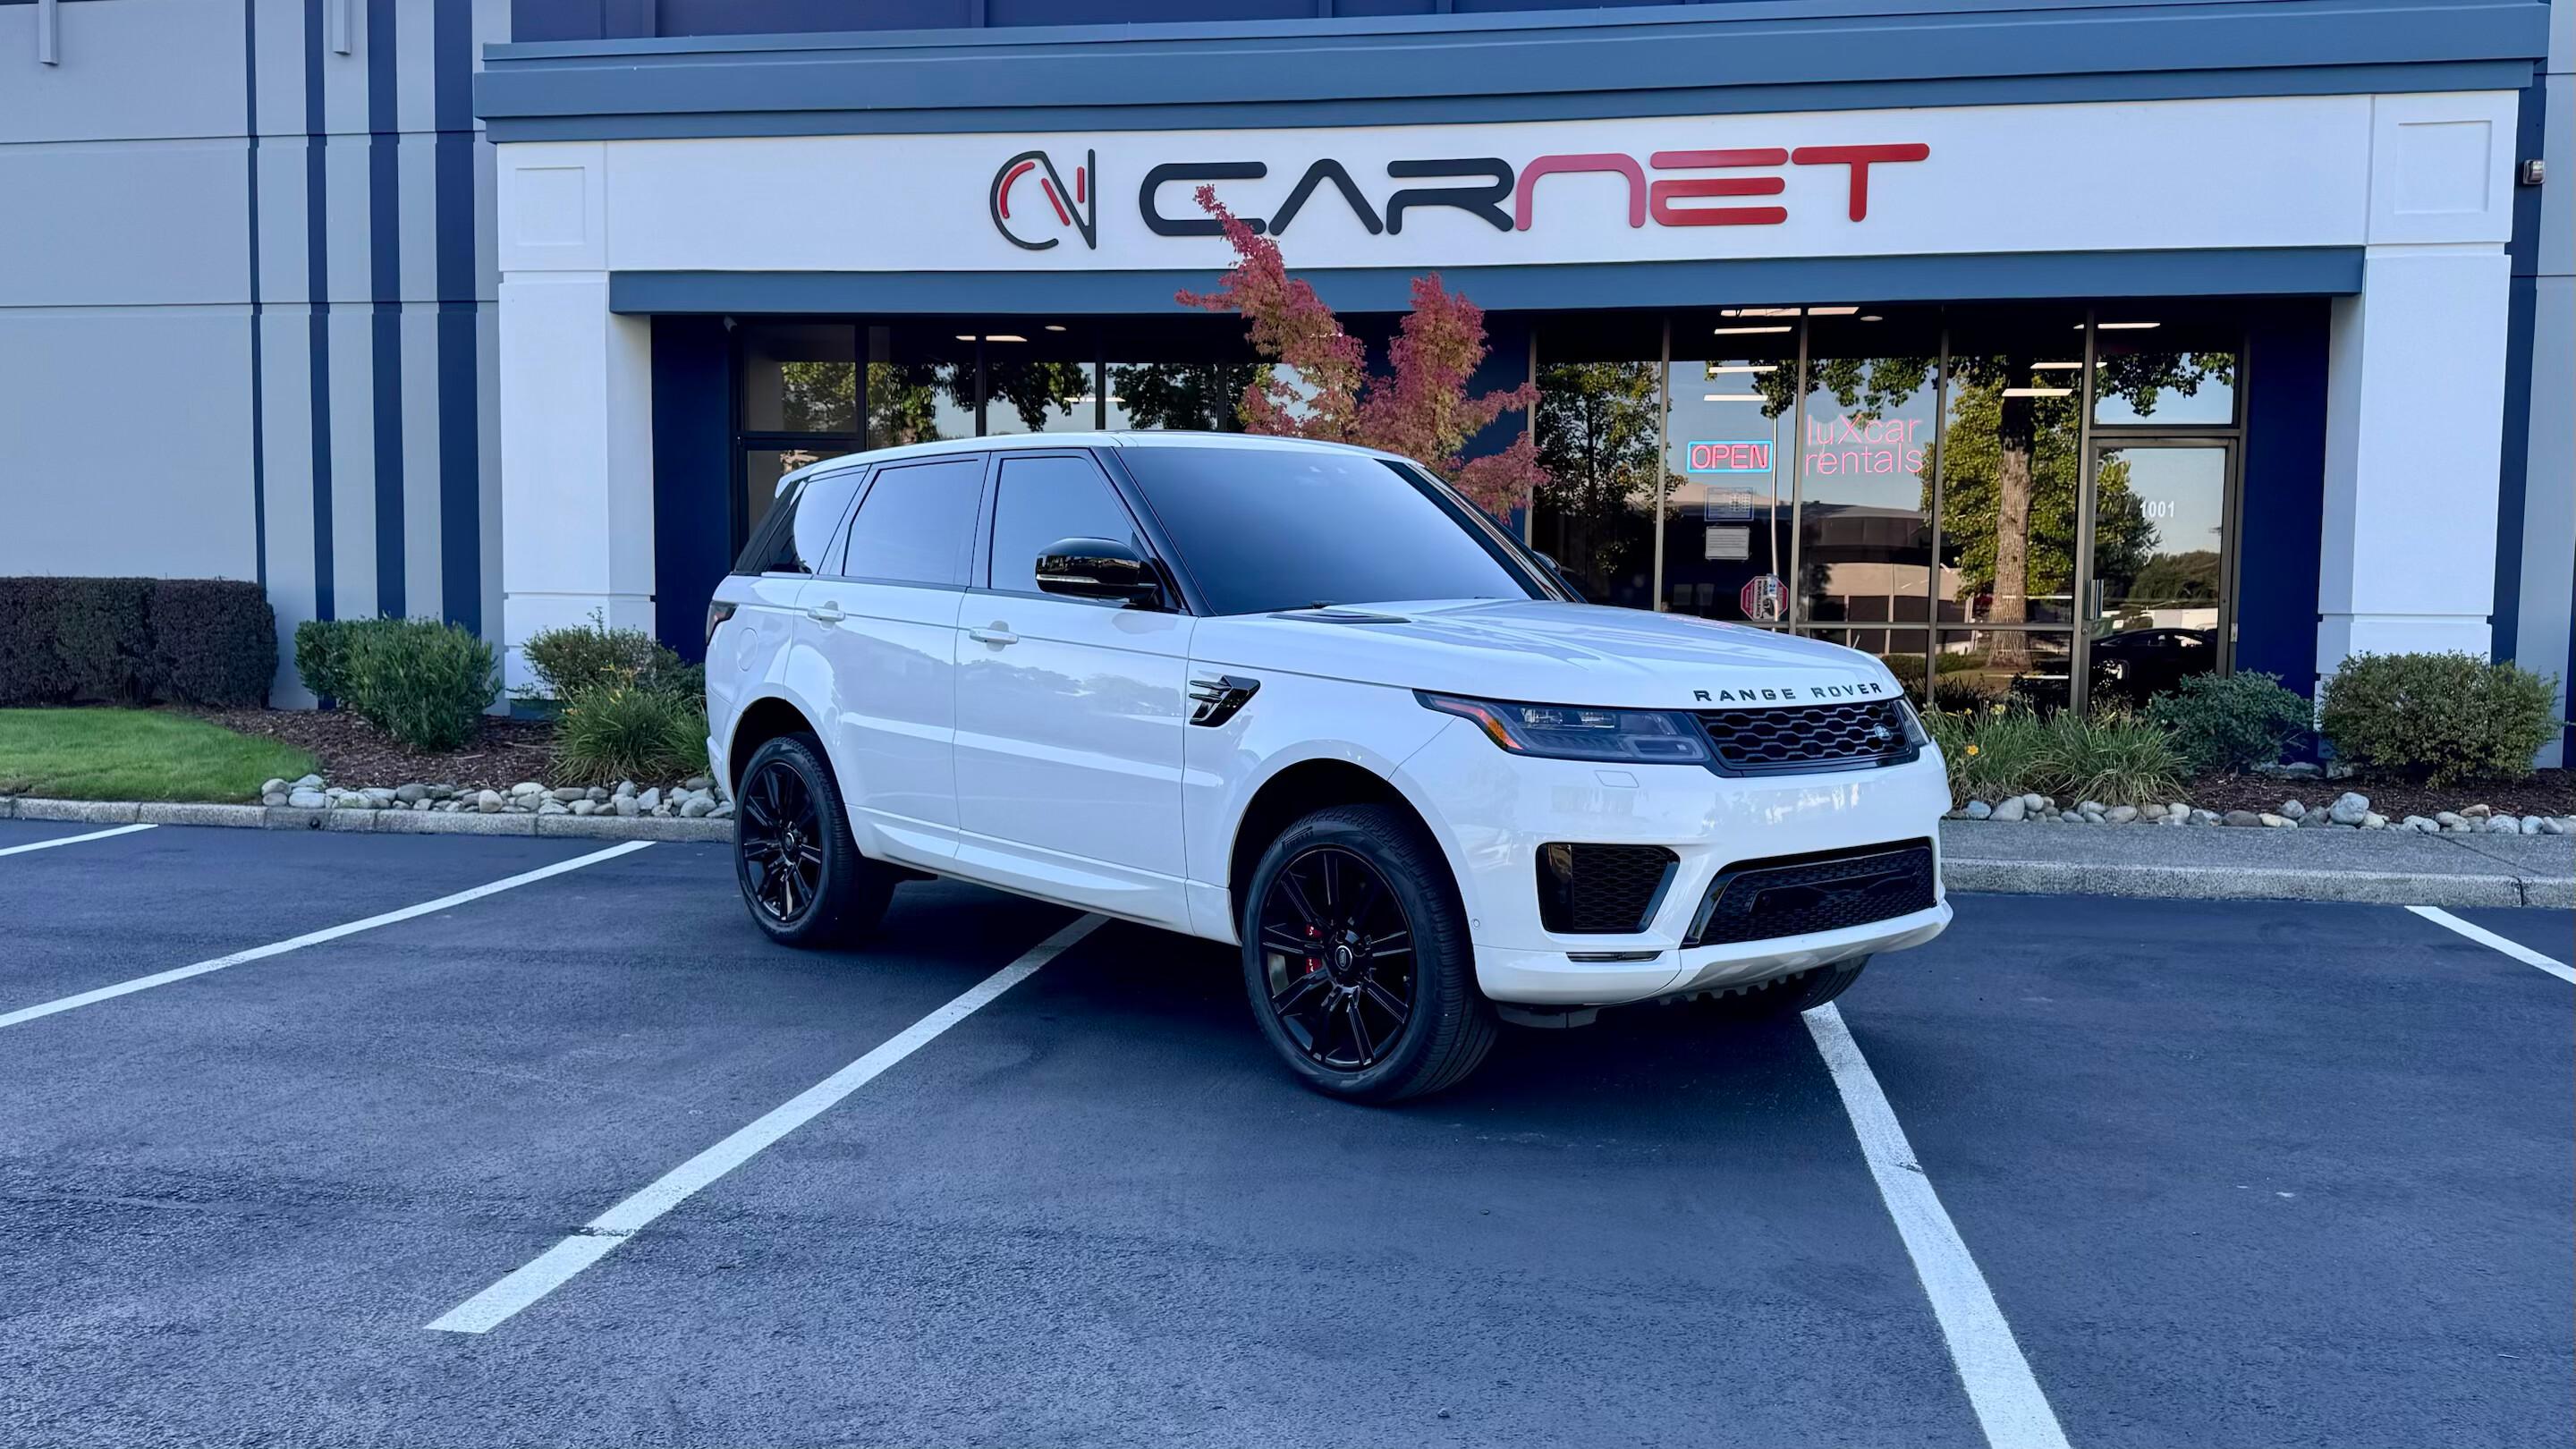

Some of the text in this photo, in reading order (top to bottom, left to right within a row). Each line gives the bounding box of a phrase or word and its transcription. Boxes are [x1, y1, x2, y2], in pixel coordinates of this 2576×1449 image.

[1690, 444, 1770, 470] OPEN
[1805, 443, 1924, 477] rentals
[2139, 500, 2175, 518] 1001
[1693, 682, 1883, 702] RANGE ROVER
